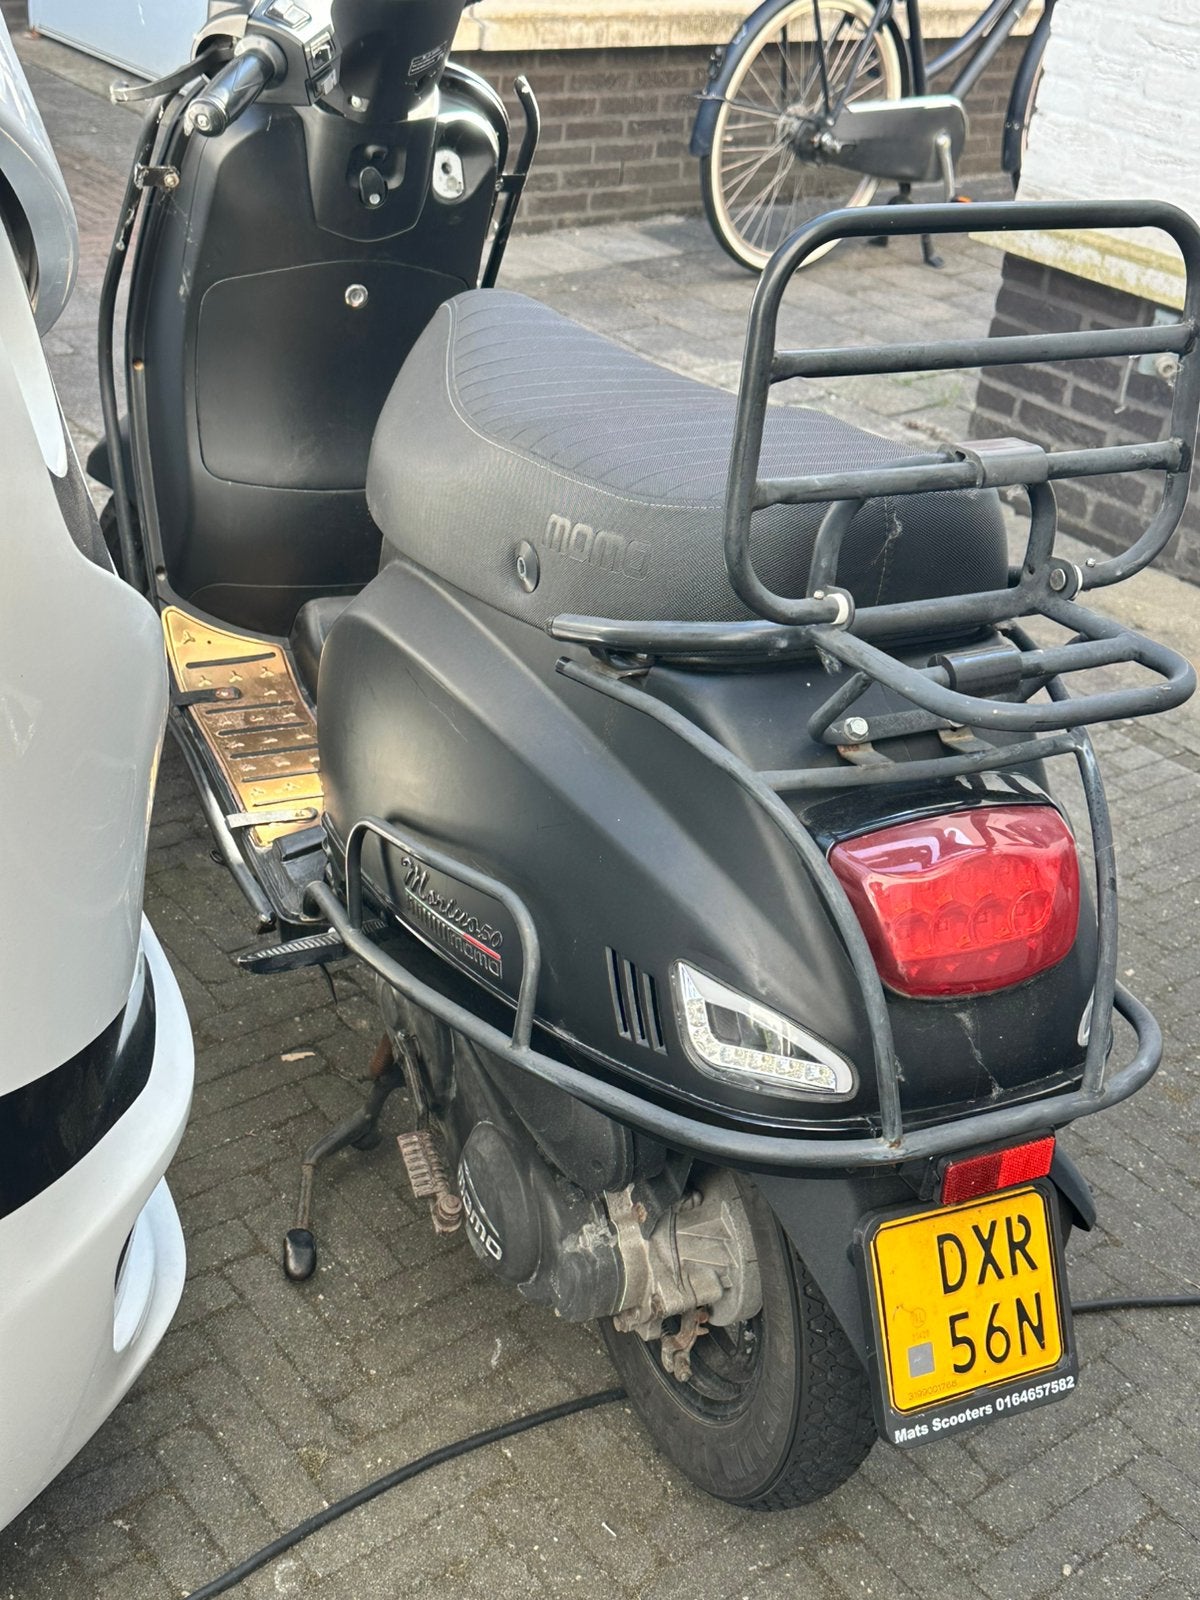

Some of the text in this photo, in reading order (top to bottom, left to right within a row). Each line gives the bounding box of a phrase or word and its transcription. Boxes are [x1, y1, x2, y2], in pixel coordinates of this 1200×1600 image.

[937, 1214, 1038, 1294] DXR
[949, 1292, 1046, 1374] 56N
[894, 1375, 1076, 1444] Mats Scooters 0164657582
